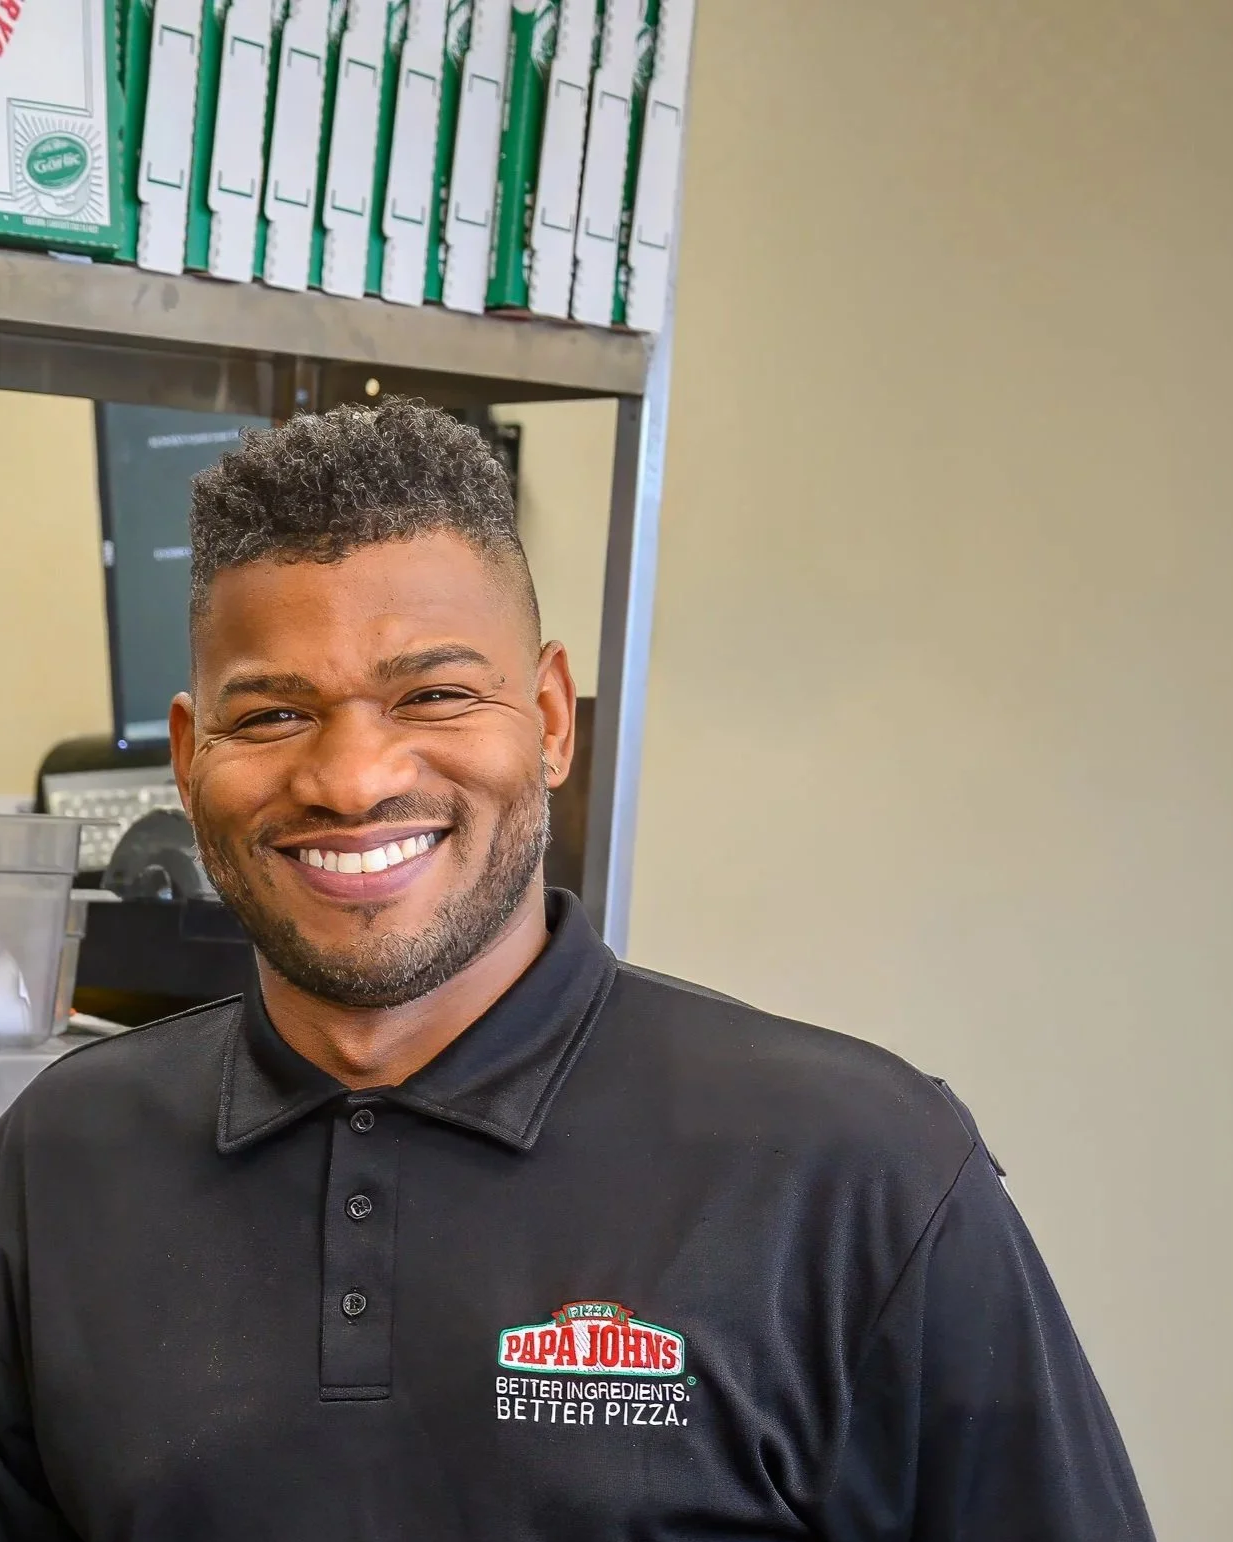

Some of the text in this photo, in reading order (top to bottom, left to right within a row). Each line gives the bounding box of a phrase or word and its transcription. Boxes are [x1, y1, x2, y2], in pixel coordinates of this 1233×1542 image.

[568, 1304, 614, 1319] PIZZA
[504, 1326, 578, 1366] PAPA
[495, 1376, 563, 1400] BETTER
[496, 1397, 688, 1426] BETTER PIZZA.
